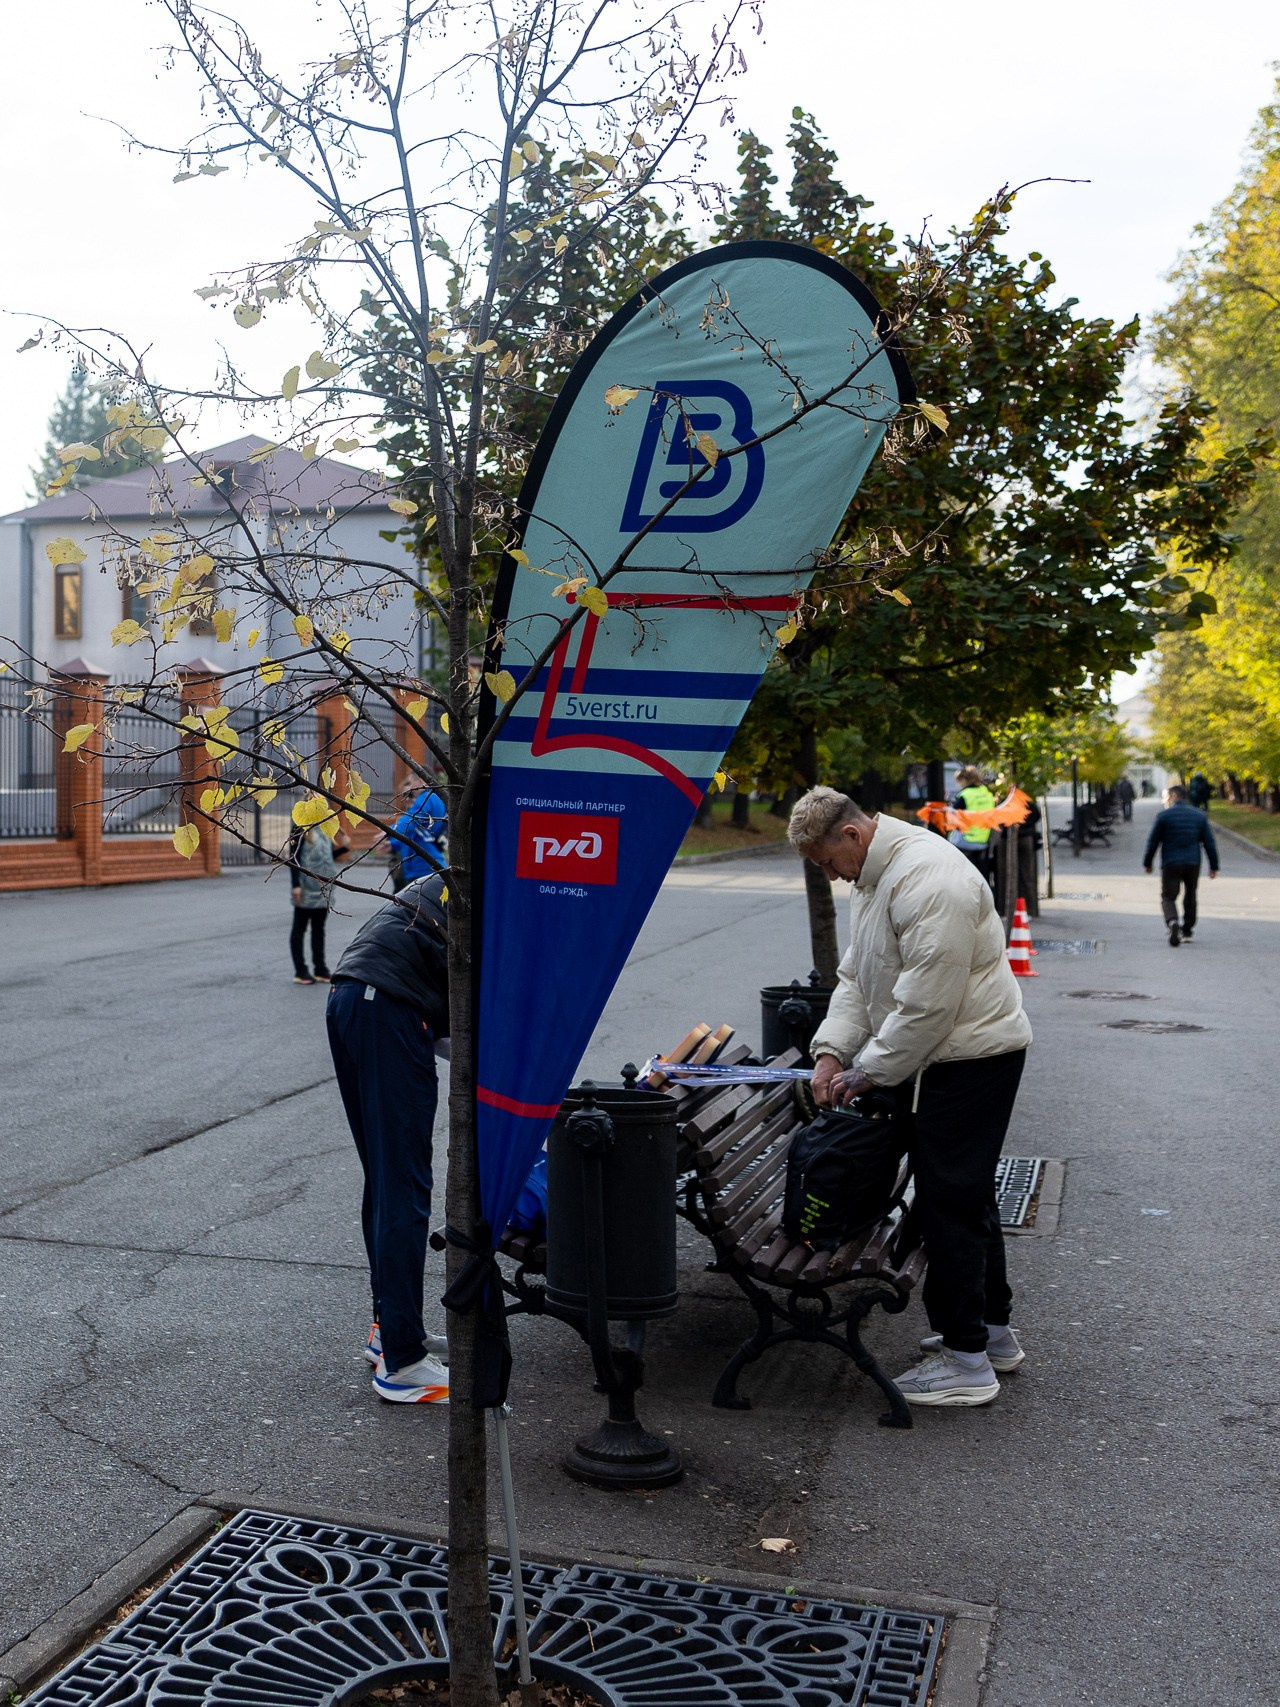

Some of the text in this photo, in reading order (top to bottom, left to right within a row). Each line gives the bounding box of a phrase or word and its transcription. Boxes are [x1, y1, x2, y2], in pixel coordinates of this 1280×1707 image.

[565, 696, 658, 720] 5verst.ru
[515, 797, 626, 813] ОФИЦИАЛЬНЫЙ ПАРТНЕР
[539, 885, 557, 895] ОАО
